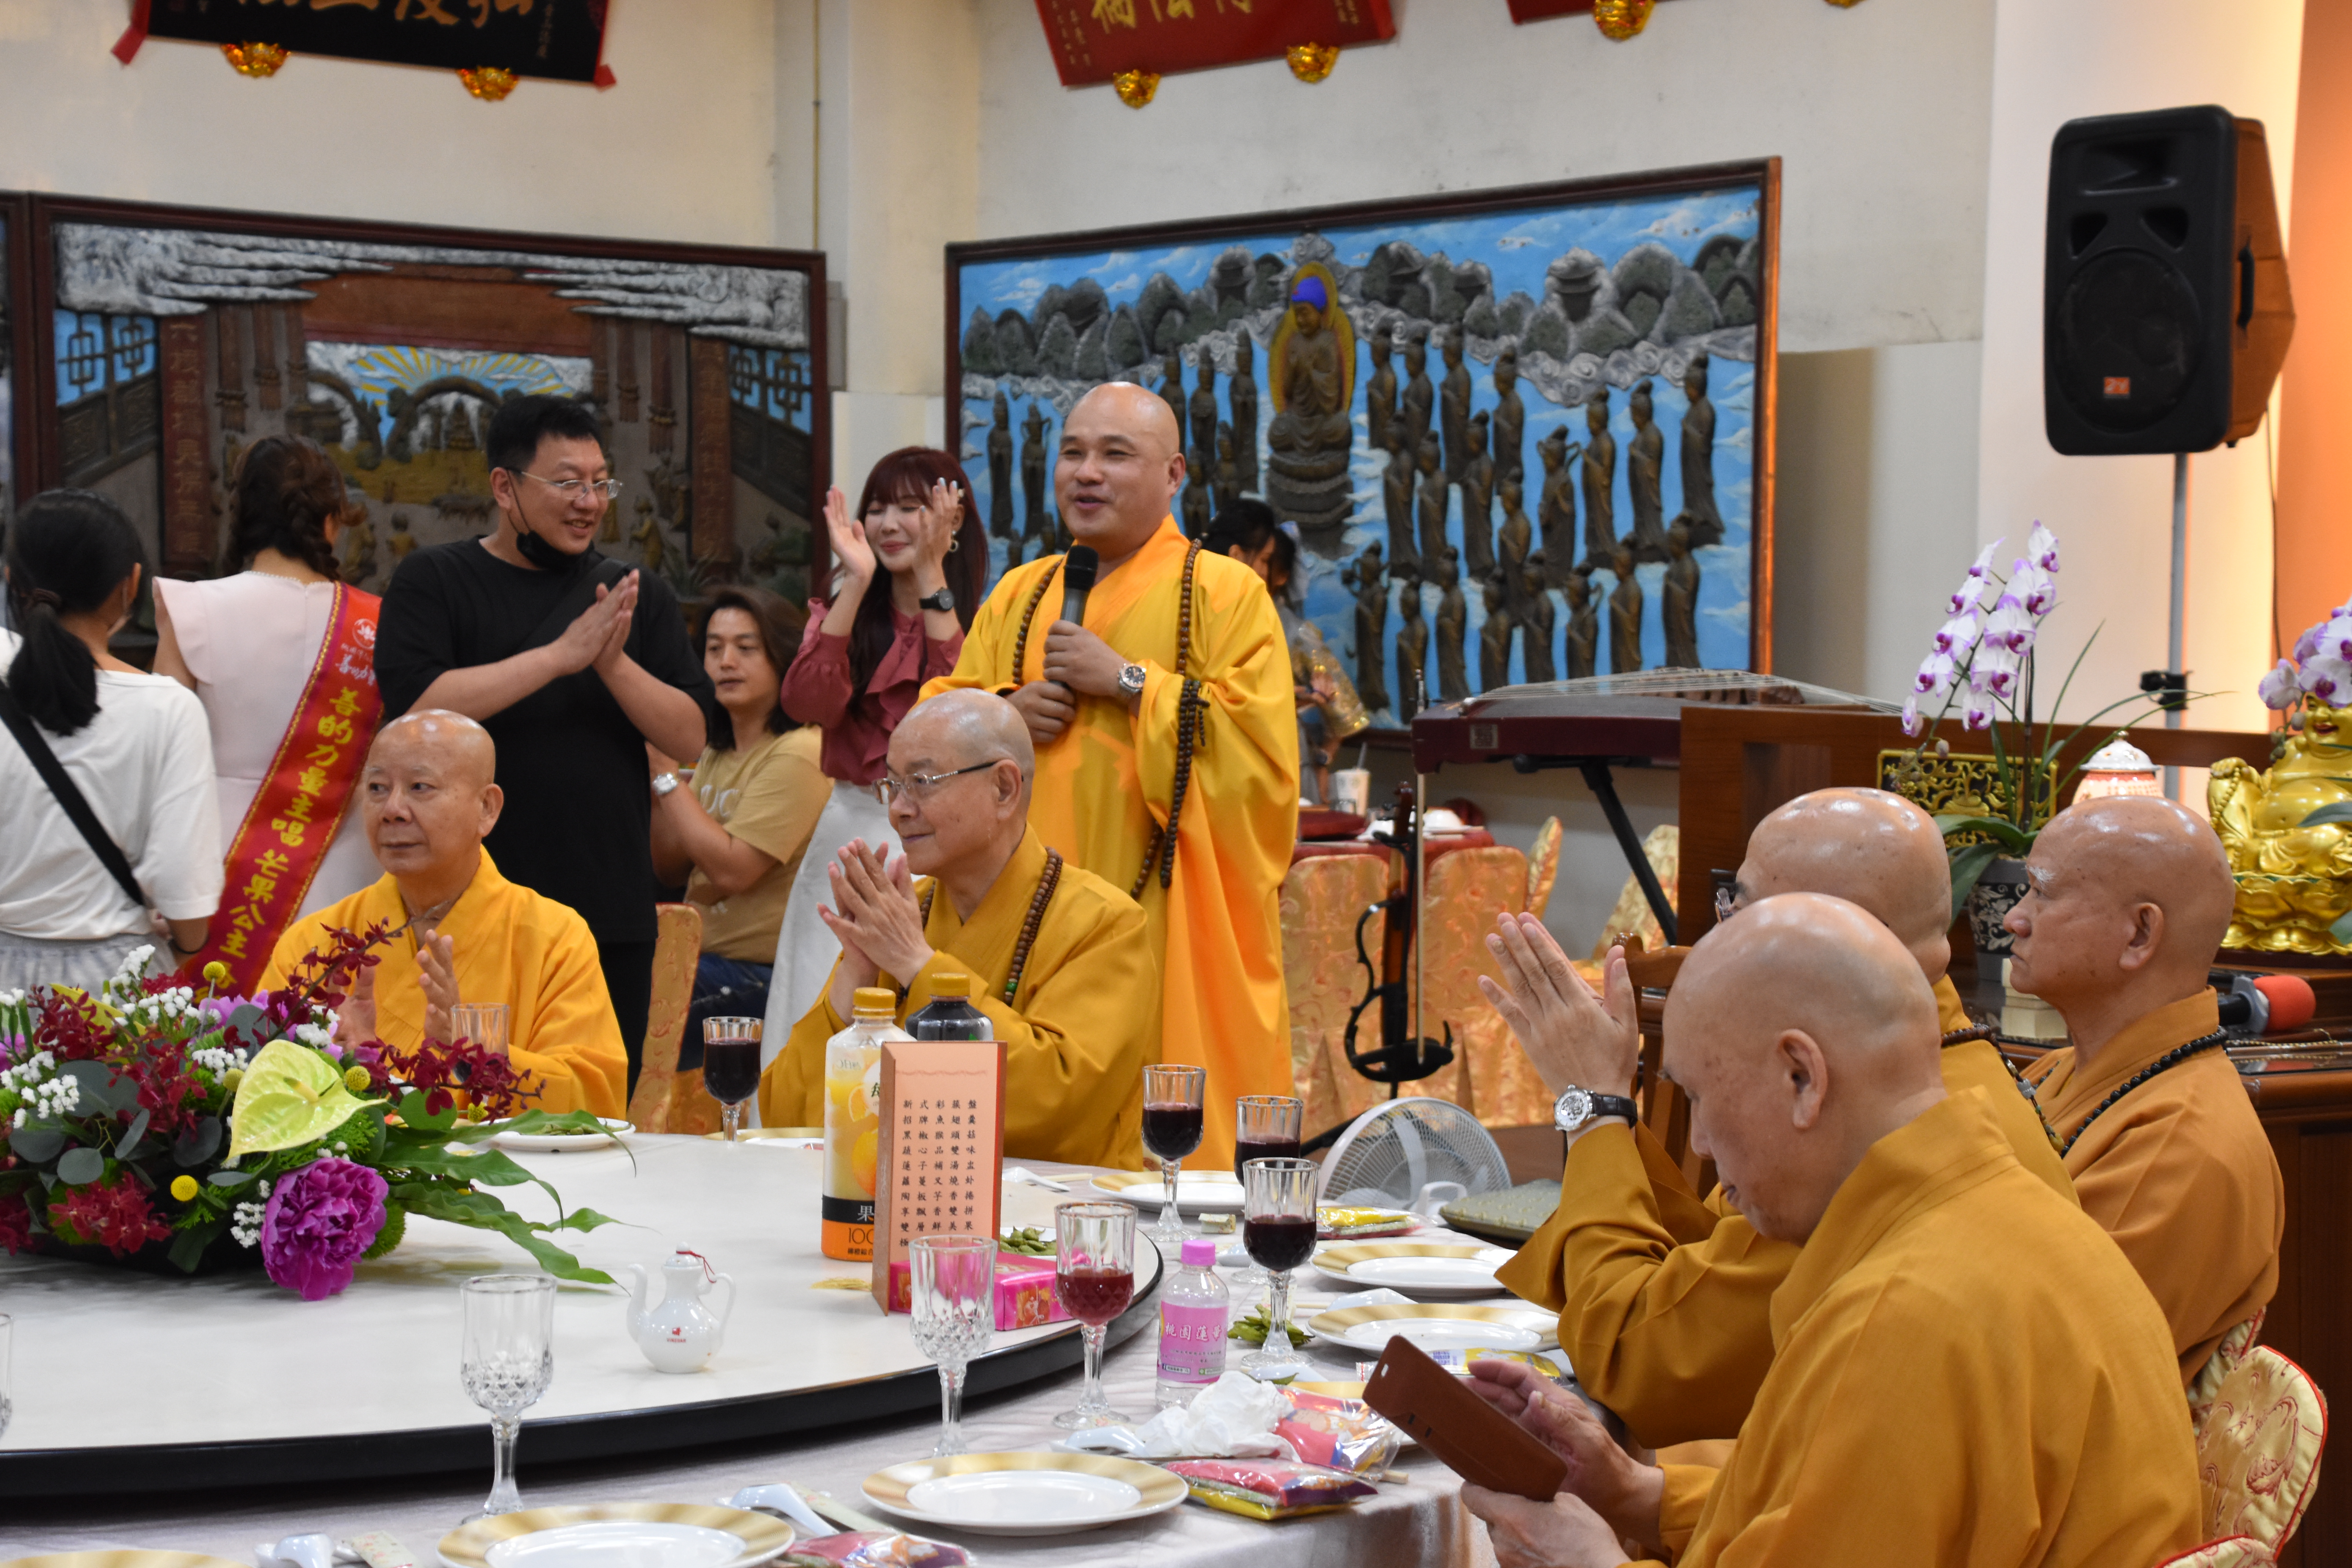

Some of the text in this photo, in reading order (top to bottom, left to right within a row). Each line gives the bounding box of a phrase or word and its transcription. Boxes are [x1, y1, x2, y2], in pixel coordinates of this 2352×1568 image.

[857, 1205, 875, 1222] 果
[1165, 1322, 1227, 1342] 桃園蓮華
